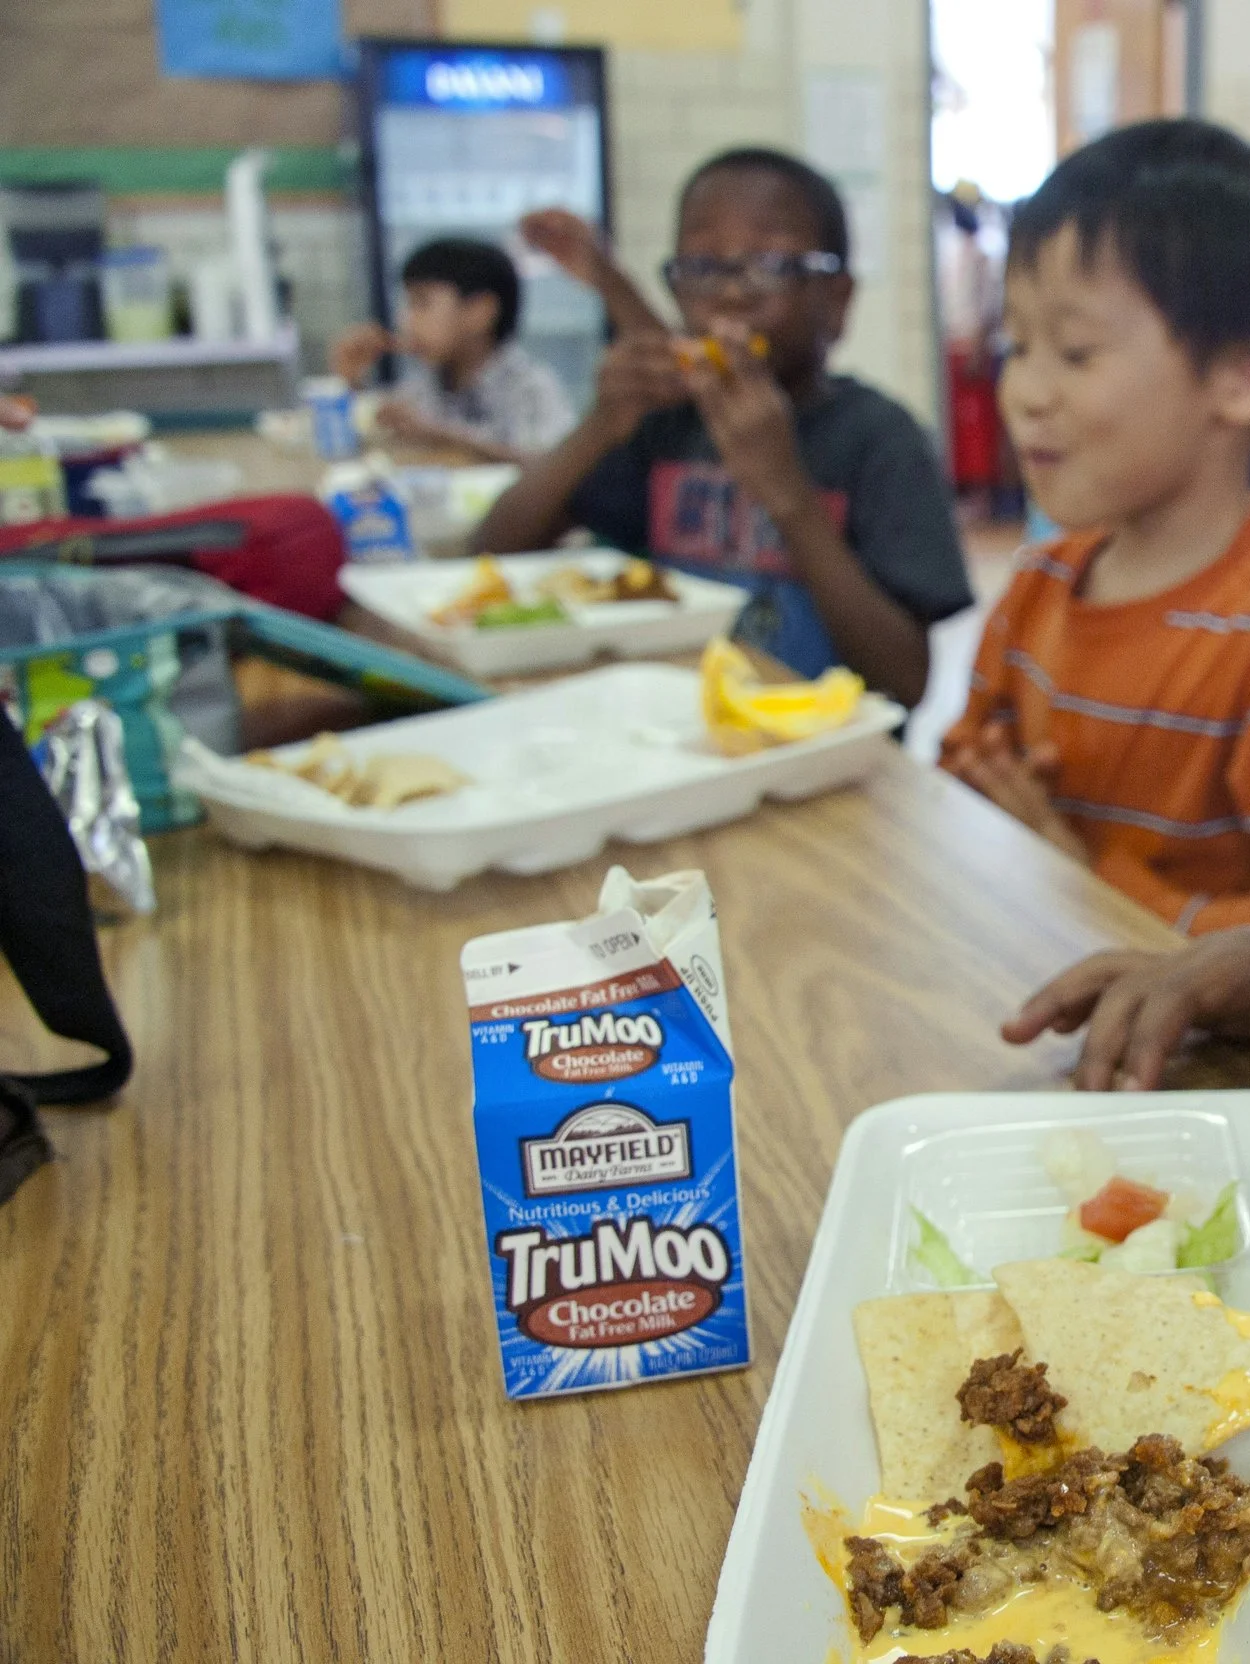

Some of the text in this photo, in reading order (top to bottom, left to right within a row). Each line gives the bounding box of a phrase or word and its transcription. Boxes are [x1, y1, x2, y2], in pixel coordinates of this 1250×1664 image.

[491, 996, 578, 1018] Chocolate
[579, 986, 607, 1007] Fat
[472, 1023, 515, 1037] VITAMIN
[522, 1012, 663, 1058] TruMoo
[552, 1049, 644, 1071] Chocolate
[539, 1135, 675, 1171] MAYFIELD
[564, 1167, 608, 1183] Dairy
[609, 1163, 653, 1178] Farms
[508, 1186, 711, 1221] Nutritious & Delicious
[501, 1220, 728, 1307] TruMoo
[548, 1290, 697, 1327] Chocolate
[569, 1313, 677, 1341] Fat Free Milk
